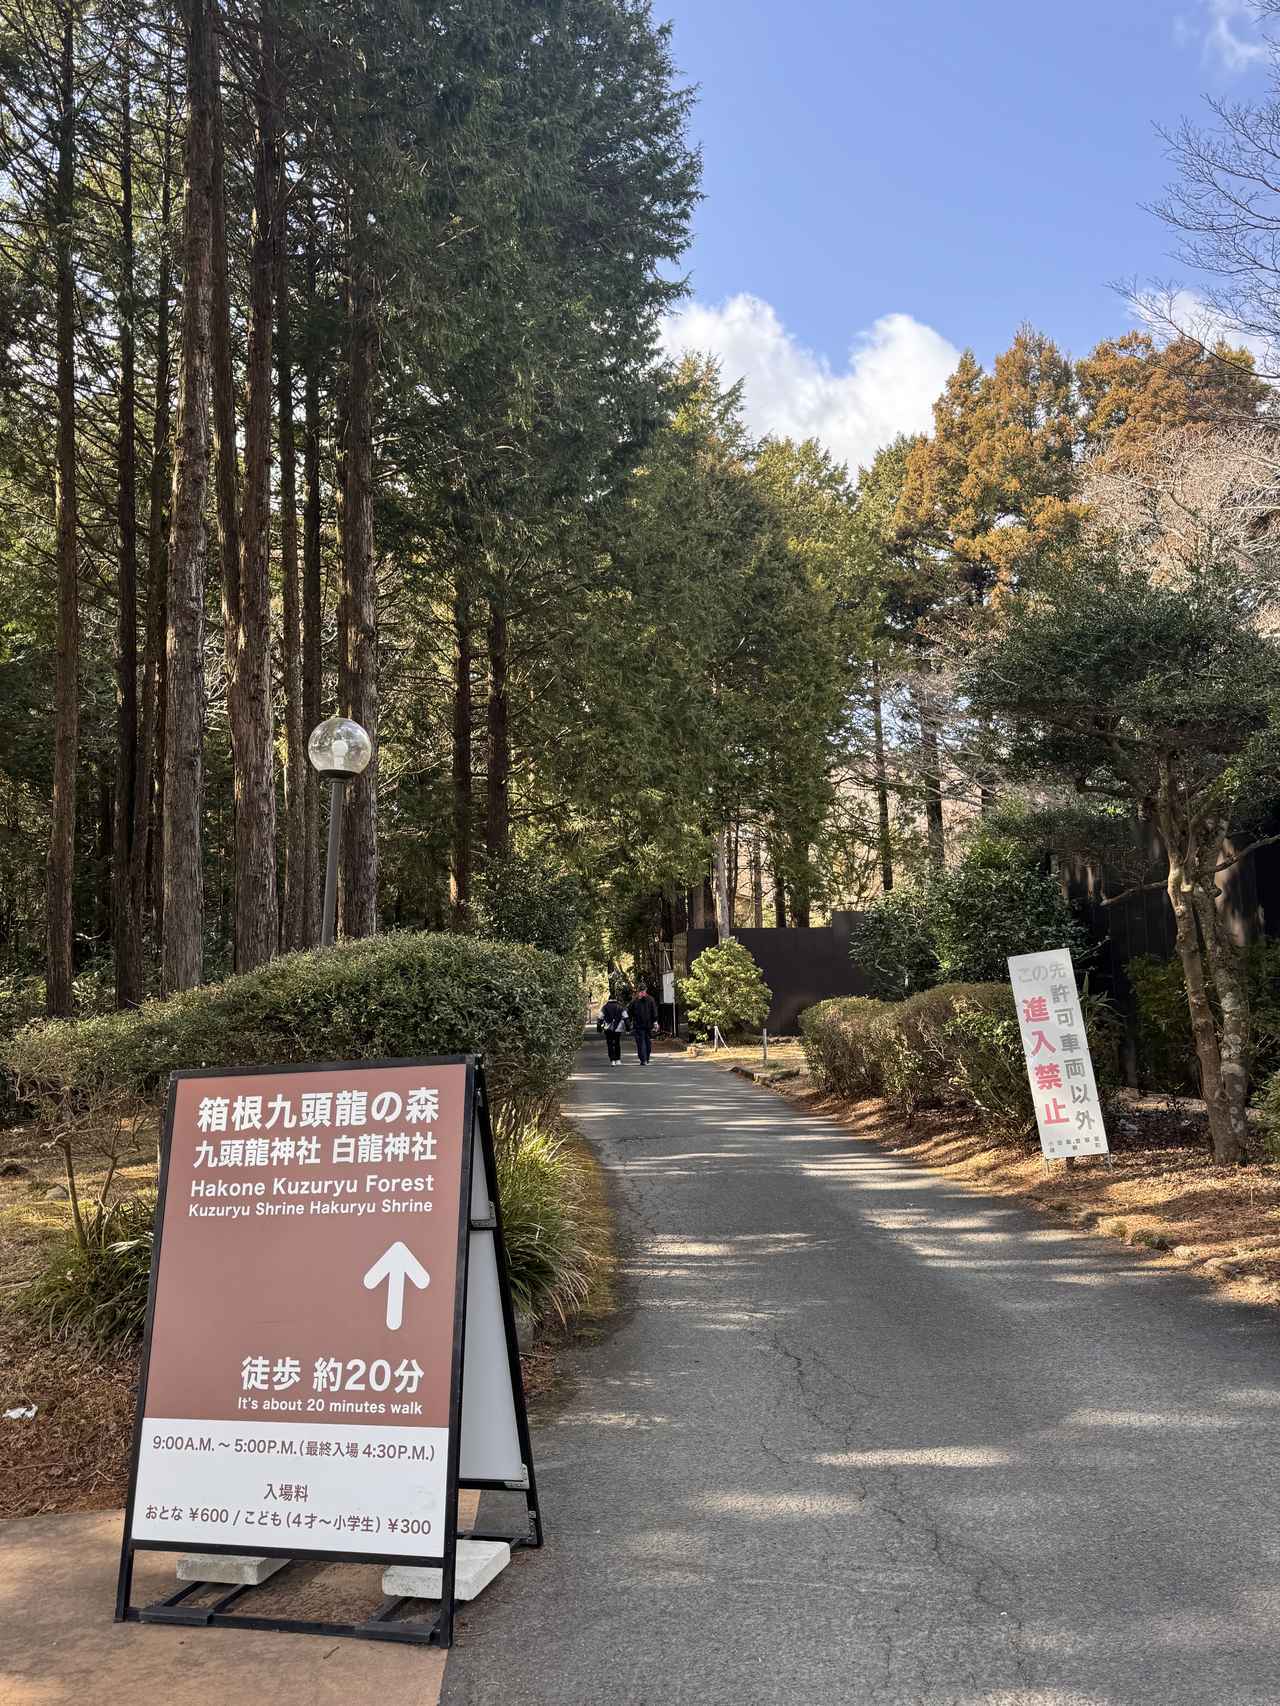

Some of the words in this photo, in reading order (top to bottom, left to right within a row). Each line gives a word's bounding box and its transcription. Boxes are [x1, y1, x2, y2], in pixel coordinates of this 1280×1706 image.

[1022, 996, 1070, 1125] 進入禁止
[197, 1087, 440, 1132] 箱根九頭龍の森
[193, 1135, 321, 1168] 九頭龍神社
[332, 1131, 437, 1164] 白龍神社
[190, 1179, 266, 1197] Hakone
[273, 1177, 358, 1197] Kuzuryu
[365, 1174, 434, 1193] Forest
[188, 1203, 251, 1219] Kuzuryu
[255, 1201, 305, 1216] Shrine
[310, 1200, 376, 1216] Hakuryu
[382, 1198, 433, 1213] Shrine
[241, 1356, 301, 1391] 徒歩
[313, 1357, 425, 1394] 約20分
[238, 1397, 258, 1410] It's
[262, 1398, 302, 1412] about
[306, 1398, 325, 1412] 20
[329, 1399, 387, 1414] minutes
[390, 1401, 423, 1415] walk
[263, 1483, 309, 1502] 入場料
[145, 1504, 183, 1521] おとな
[387, 1517, 432, 1535] ¥300
